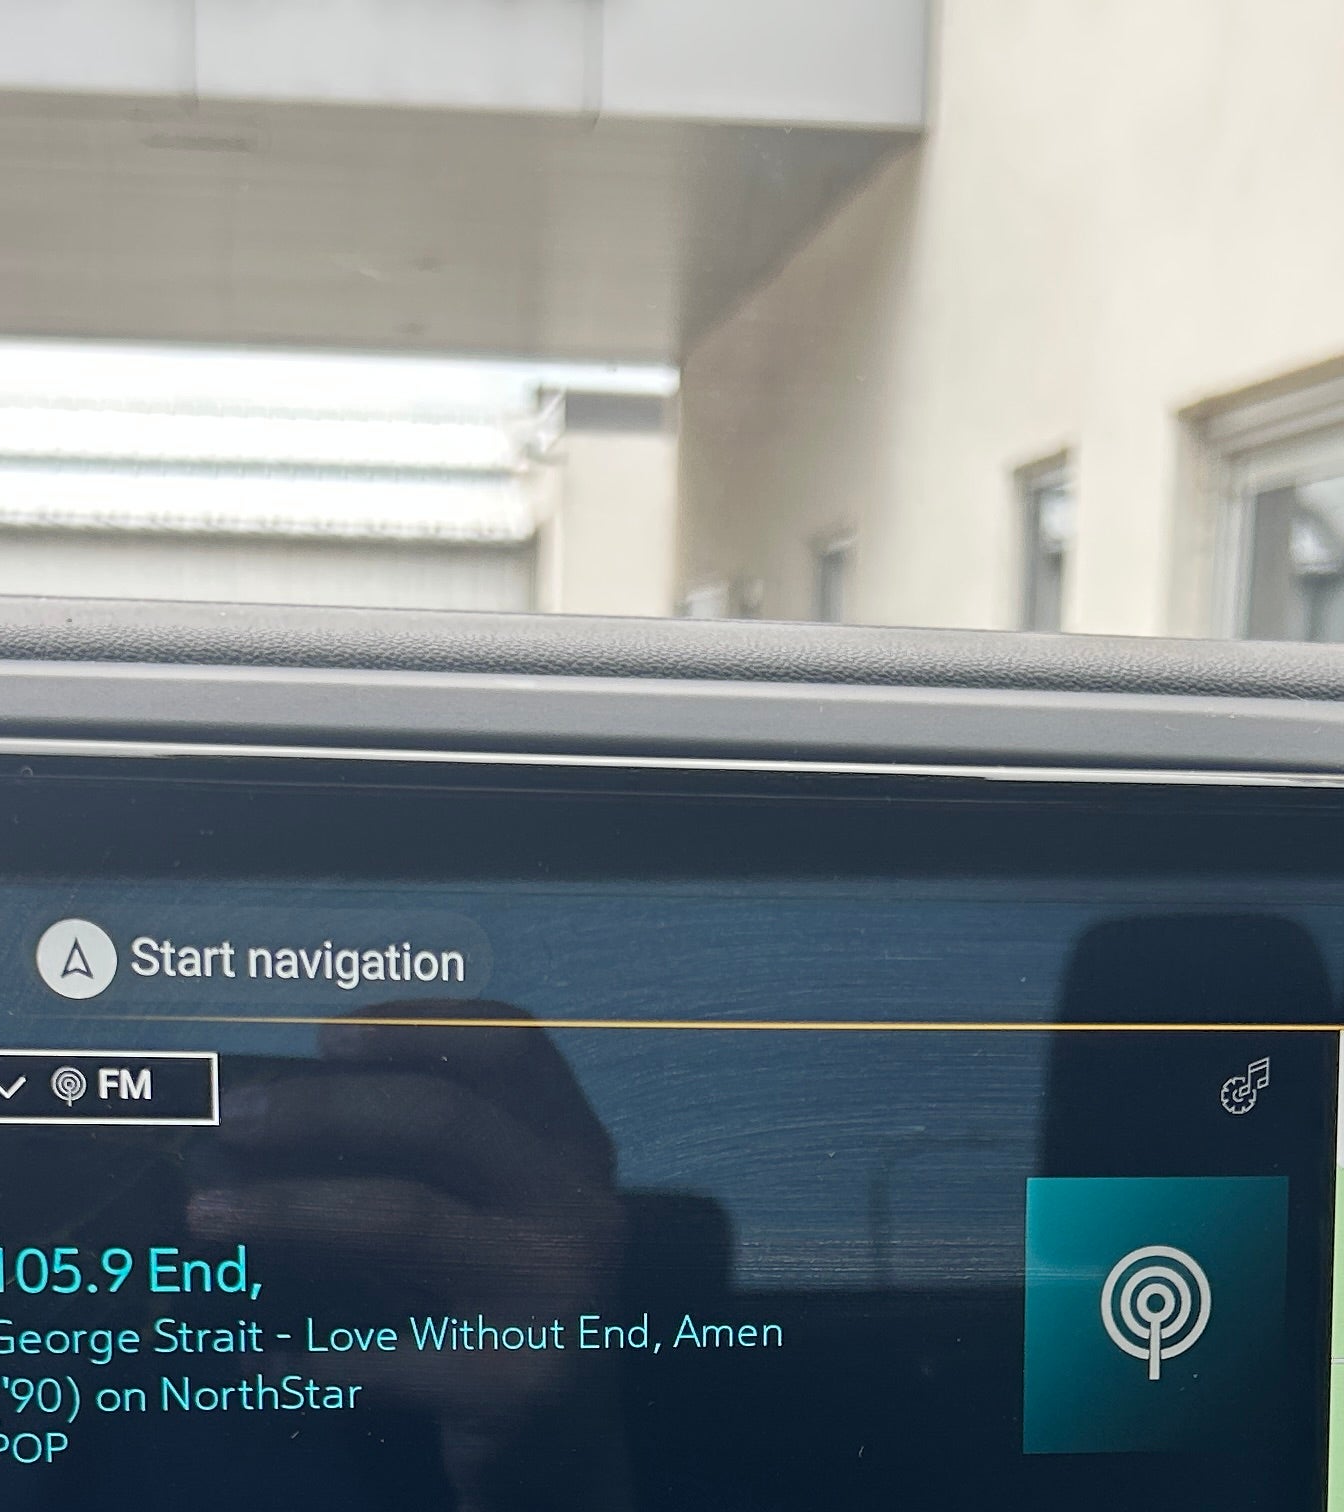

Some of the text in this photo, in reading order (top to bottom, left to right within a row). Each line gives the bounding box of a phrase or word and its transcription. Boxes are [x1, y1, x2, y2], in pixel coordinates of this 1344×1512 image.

[132, 936, 465, 989] Start navigation
[98, 1070, 152, 1099] FM
[150, 1246, 262, 1300] End,
[154, 1319, 265, 1354] Strait
[307, 1317, 397, 1353] Love
[409, 1315, 566, 1351] Without
[579, 1314, 662, 1356] End,
[672, 1316, 784, 1350] Amen
[96, 1384, 146, 1412] on
[162, 1375, 363, 1411] NorthStar
